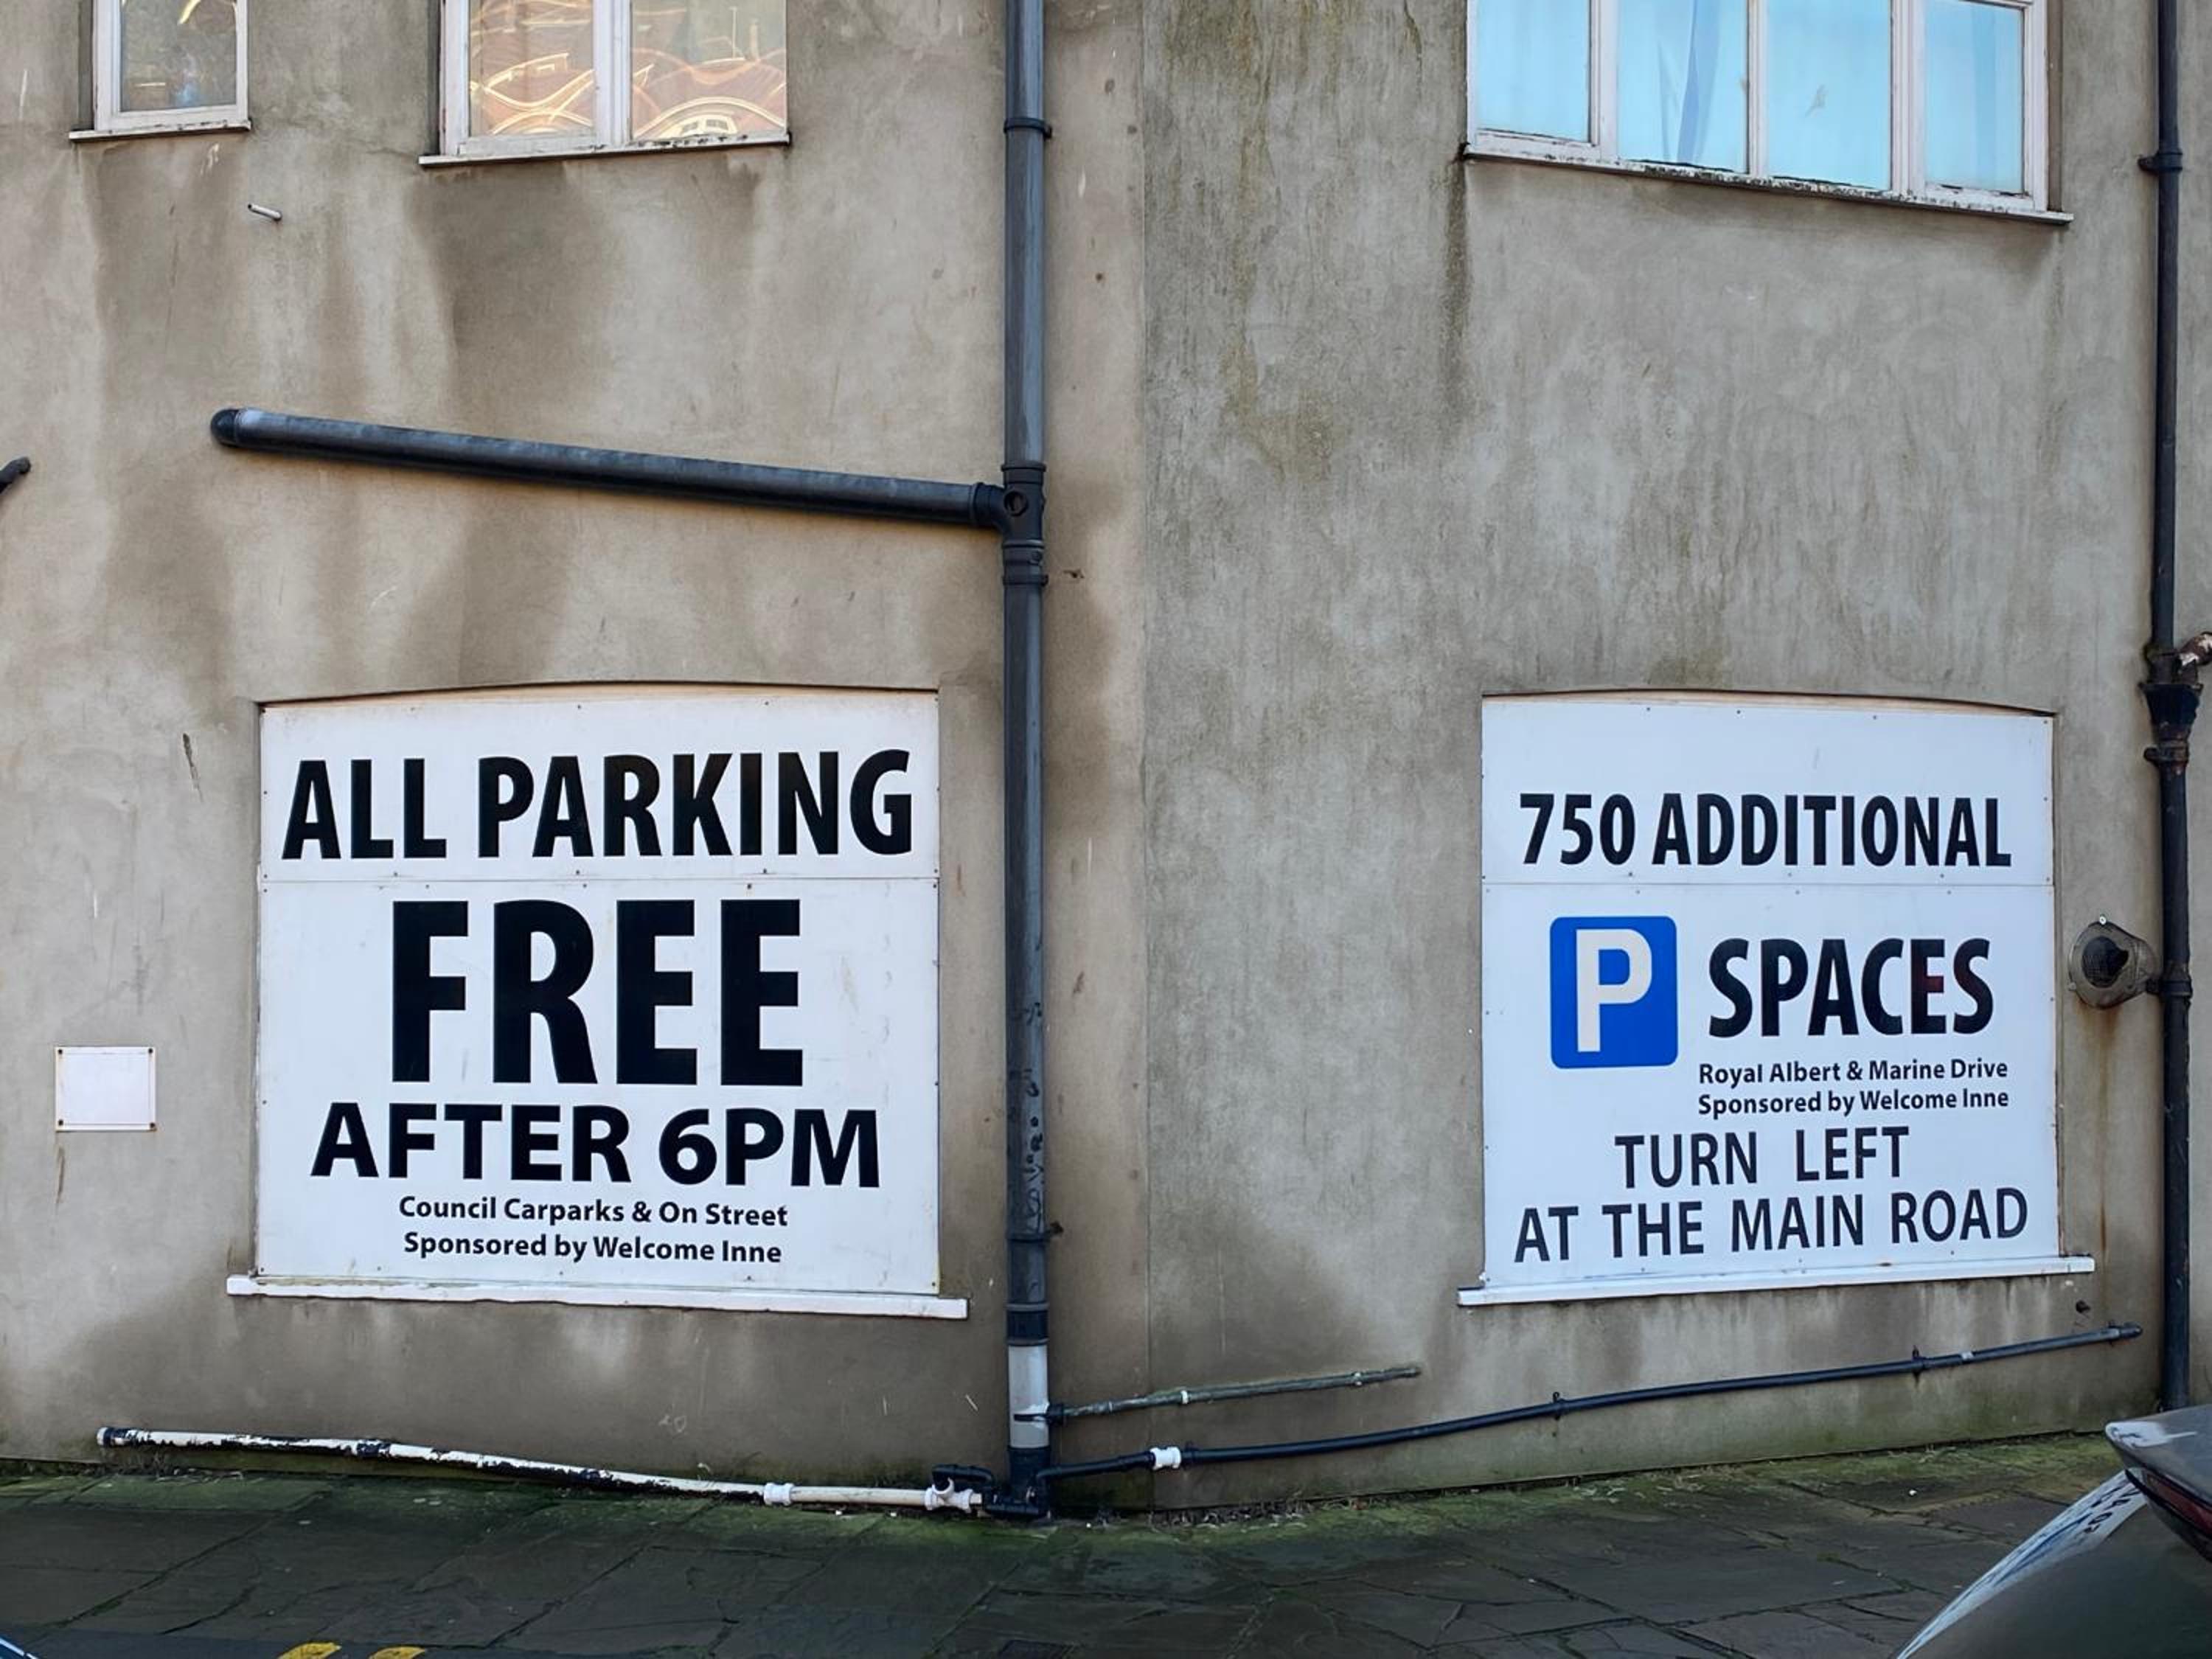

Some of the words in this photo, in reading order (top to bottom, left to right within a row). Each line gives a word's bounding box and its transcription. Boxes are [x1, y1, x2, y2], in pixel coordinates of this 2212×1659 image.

[281, 758, 447, 860] ALL
[478, 748, 912, 858] PARKING
[1520, 793, 1635, 866] 750
[1651, 793, 2011, 867] ADDITIONAL
[392, 899, 803, 1087] FREE
[1575, 928, 1652, 1052] P
[1708, 938, 1994, 1038] SPACES
[1698, 1091, 1821, 1119] Sponsored
[1828, 1090, 1855, 1117] by
[1859, 1088, 1958, 1110] Welcome
[1963, 1088, 2009, 1107] Inne
[1700, 1063, 1763, 1090] Royal
[1769, 1060, 1841, 1082] Albert
[1846, 1060, 1863, 1081] &
[1869, 1060, 1945, 1080] Marine
[1951, 1058, 2008, 1079] Drive
[310, 1102, 632, 1183] AFTER
[658, 1107, 880, 1188] 6PM
[1614, 1131, 1757, 1189] TURN
[1795, 1126, 1910, 1182] LEFT
[399, 1195, 496, 1219] Council
[504, 1198, 625, 1226] Carparks
[632, 1200, 652, 1222] &
[658, 1201, 698, 1224] On
[706, 1203, 787, 1227] Street
[404, 1231, 546, 1259] Sponsored
[554, 1234, 588, 1263] by
[593, 1236, 714, 1261] Welcome
[722, 1240, 782, 1263] Inne
[1514, 1206, 1579, 1263] AT
[1601, 1200, 1704, 1259] THE
[1731, 1194, 1863, 1253] MAIN
[1891, 1187, 2028, 1244] ROAD
